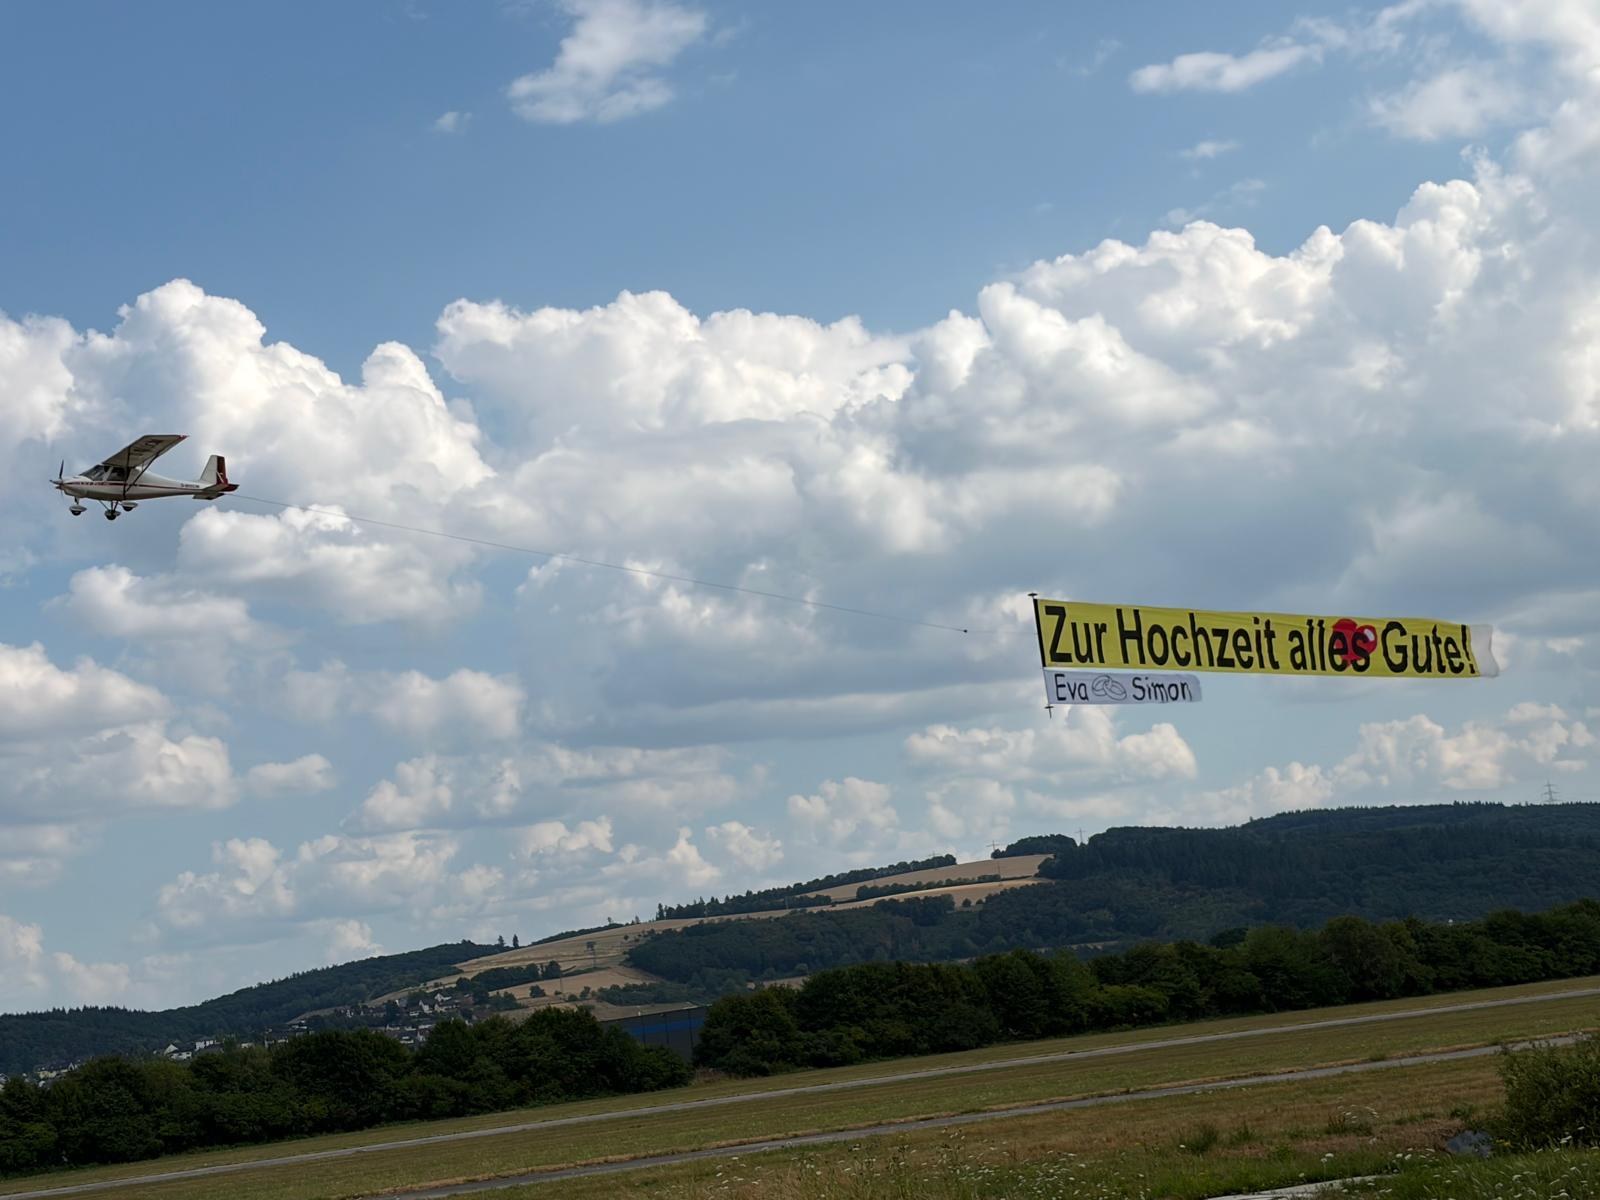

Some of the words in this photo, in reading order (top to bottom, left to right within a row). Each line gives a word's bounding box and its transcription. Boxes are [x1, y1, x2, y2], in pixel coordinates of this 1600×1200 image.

[1044, 605, 1107, 664] Zur
[1115, 608, 1280, 670] Hochzeit
[1288, 619, 1371, 672] alles
[1381, 621, 1476, 674] Gute!
[1054, 673, 1089, 701] Eva
[1132, 677, 1193, 703] Simon
